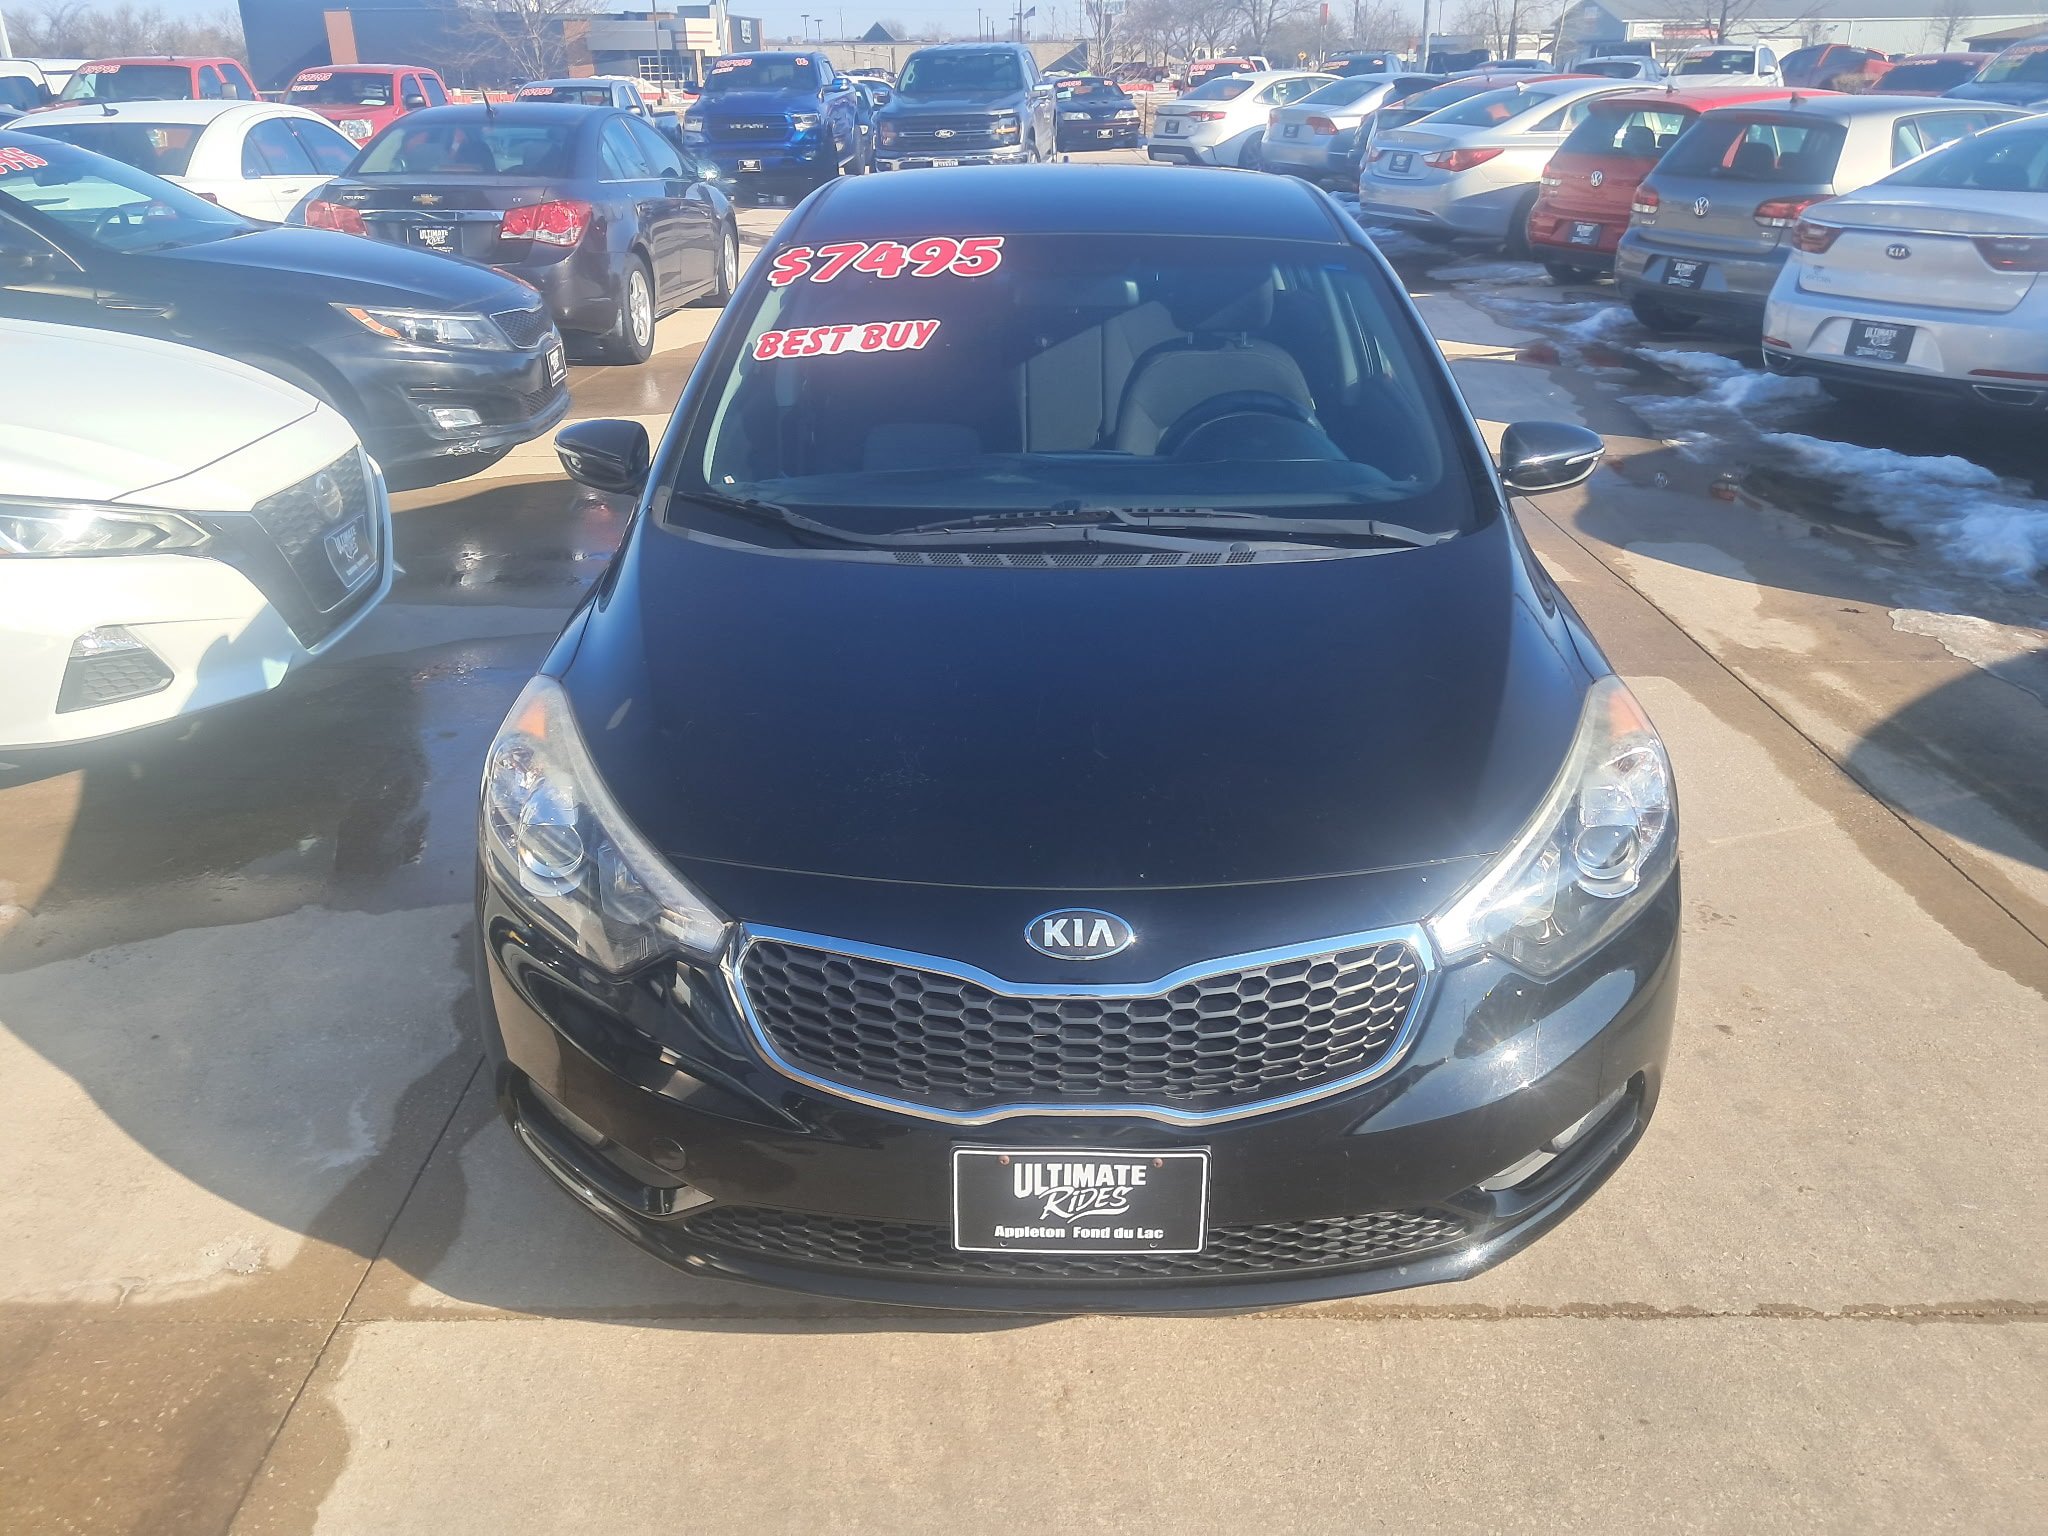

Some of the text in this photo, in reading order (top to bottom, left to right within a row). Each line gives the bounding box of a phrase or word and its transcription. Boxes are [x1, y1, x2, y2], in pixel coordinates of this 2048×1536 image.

[767, 236, 1005, 287] $7495
[1887, 247, 1907, 257] KIA
[753, 320, 940, 360] BEST BUY
[1864, 326, 1898, 341] ULTIMATE
[1043, 918, 1116, 947] KIA
[1014, 1163, 1147, 1199] ULTIMATE
[994, 1225, 1164, 1239] Appleton Fond du Lac
